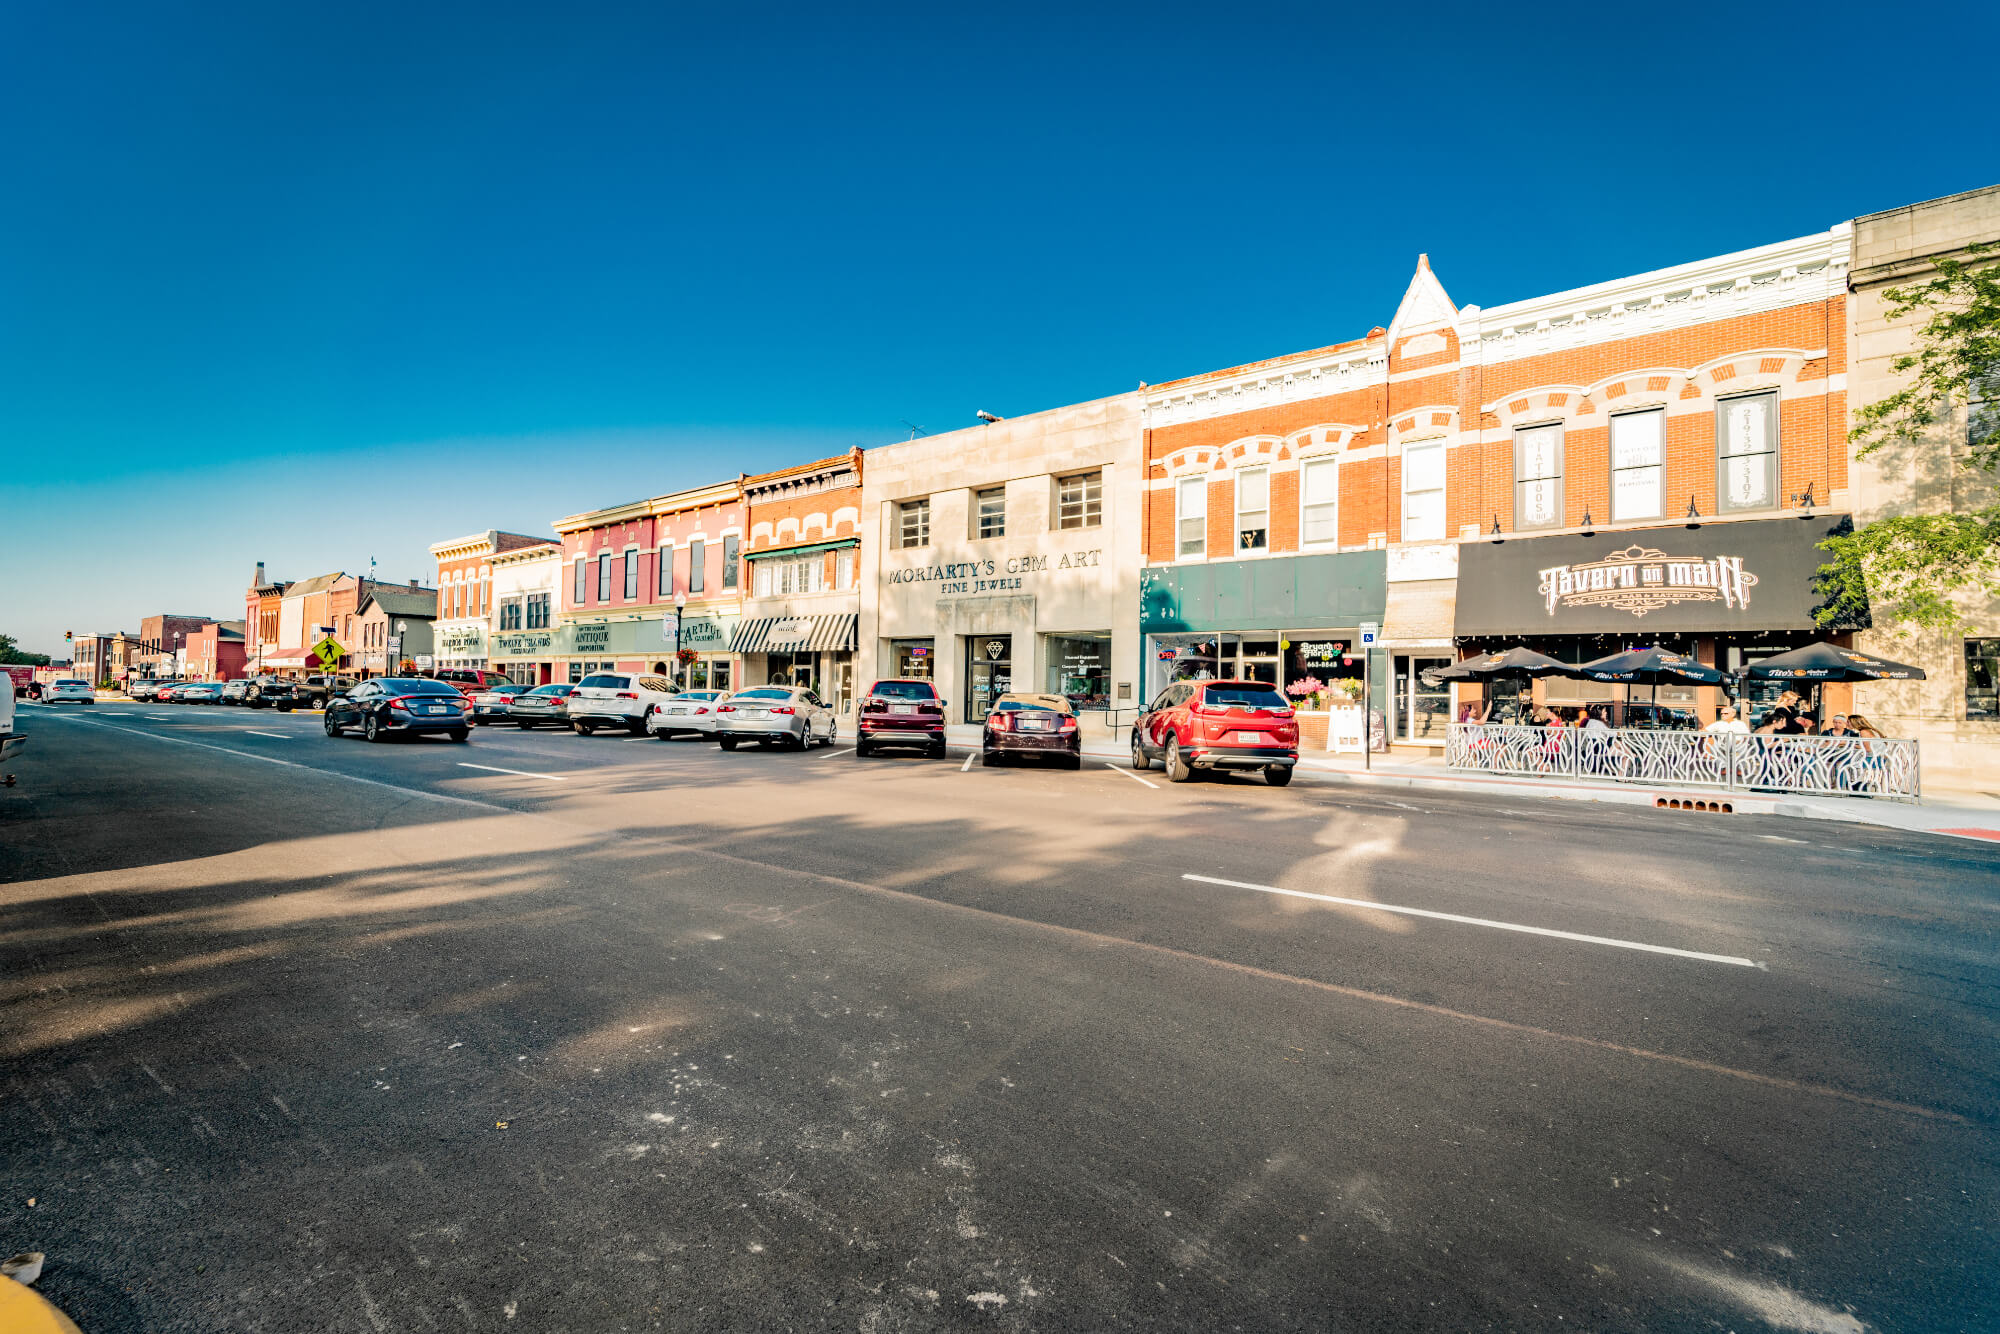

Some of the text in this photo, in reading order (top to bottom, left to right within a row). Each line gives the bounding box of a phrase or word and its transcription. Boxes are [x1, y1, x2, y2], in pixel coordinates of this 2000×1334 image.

[888, 548, 1102, 585] MORIARTY'S GEM ART
[941, 577, 1022, 594] FINE JEWELE
[1538, 564, 1637, 616] Tavern
[575, 631, 609, 645] ANTIQUE
[684, 622, 722, 641] ARTFUL
[498, 637, 551, 649] TWELVE ISLANDS
[577, 644, 606, 652] EMPORIUM
[1157, 650, 1176, 660] OPEN
[1768, 669, 1794, 677] Tito's
